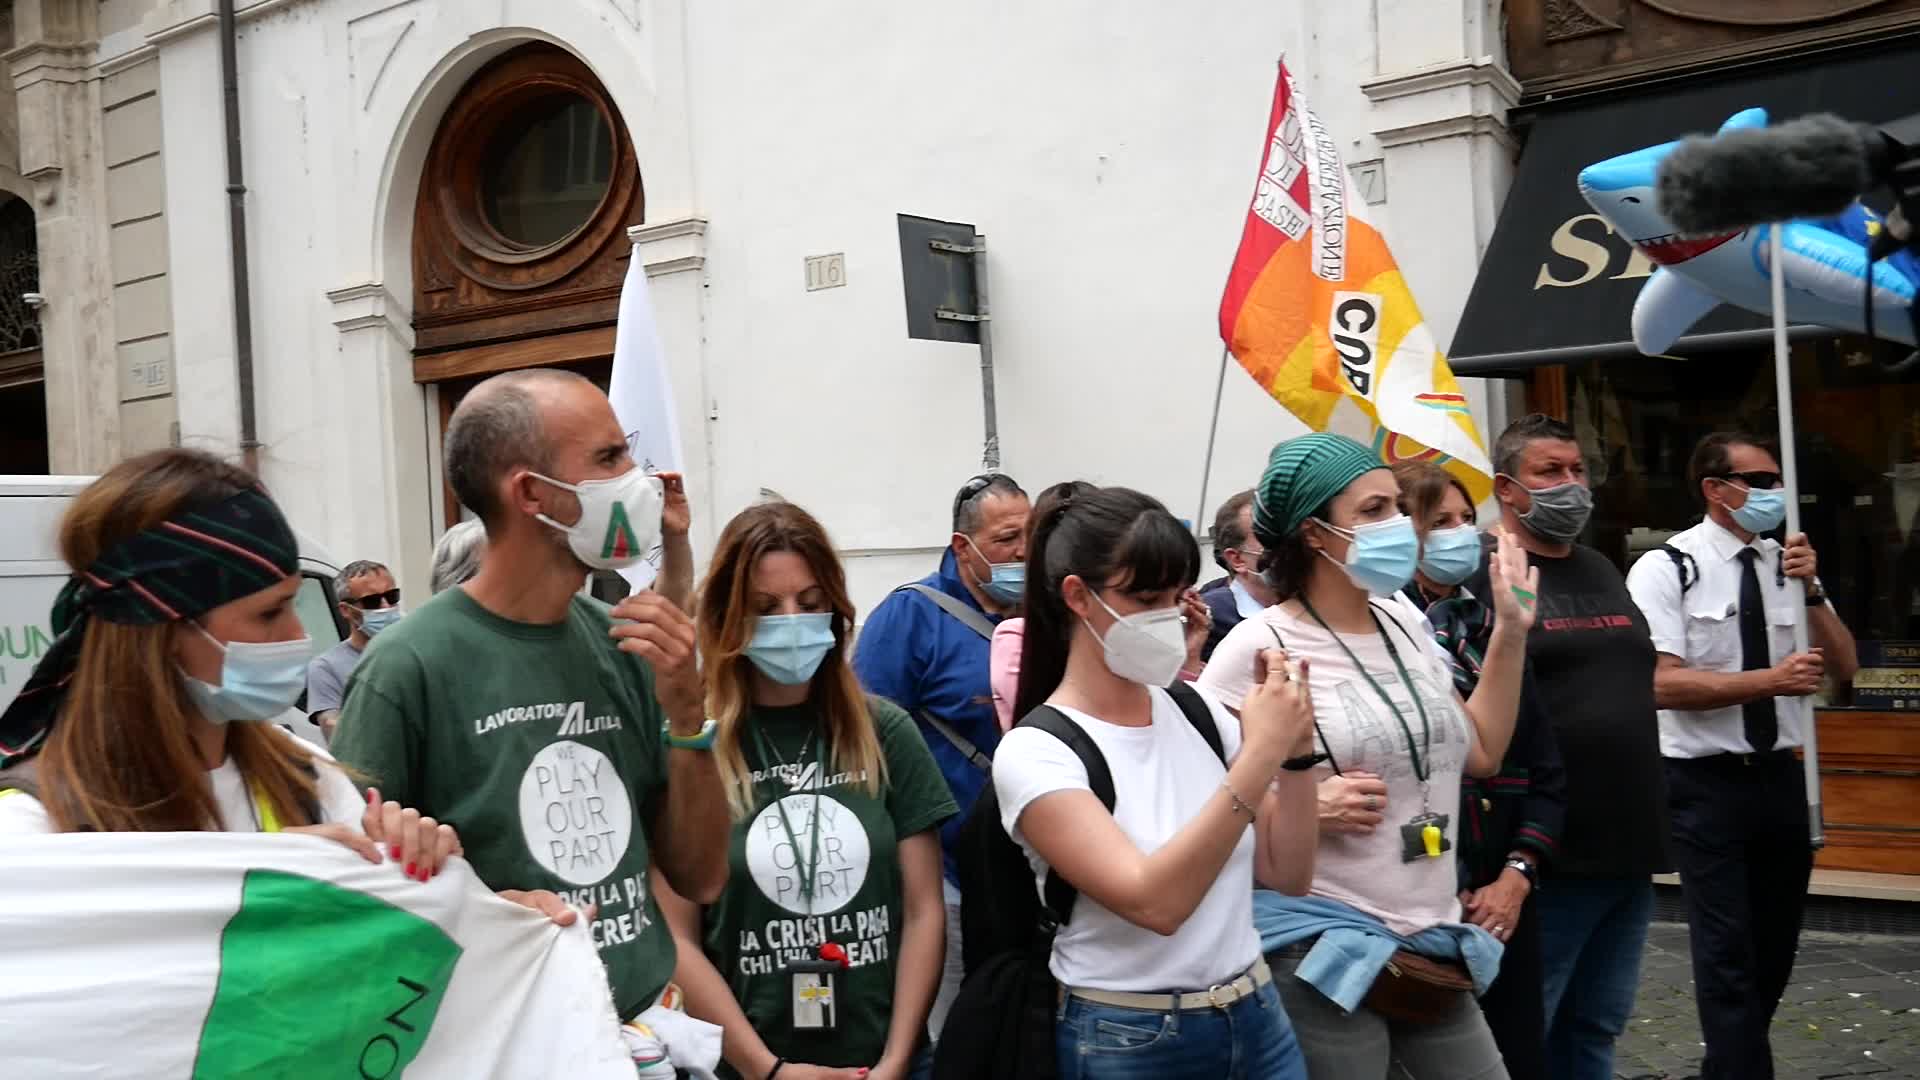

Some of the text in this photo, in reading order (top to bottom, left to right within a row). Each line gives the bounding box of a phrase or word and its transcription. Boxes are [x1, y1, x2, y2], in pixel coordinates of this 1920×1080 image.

[535, 758, 603, 798] PLAY
[545, 796, 609, 834] OUR
[549, 830, 617, 871] PART
[599, 883, 622, 906] LA
[765, 916, 827, 950] CRISI
[830, 914, 853, 934] LA
[739, 954, 773, 976] CHI
